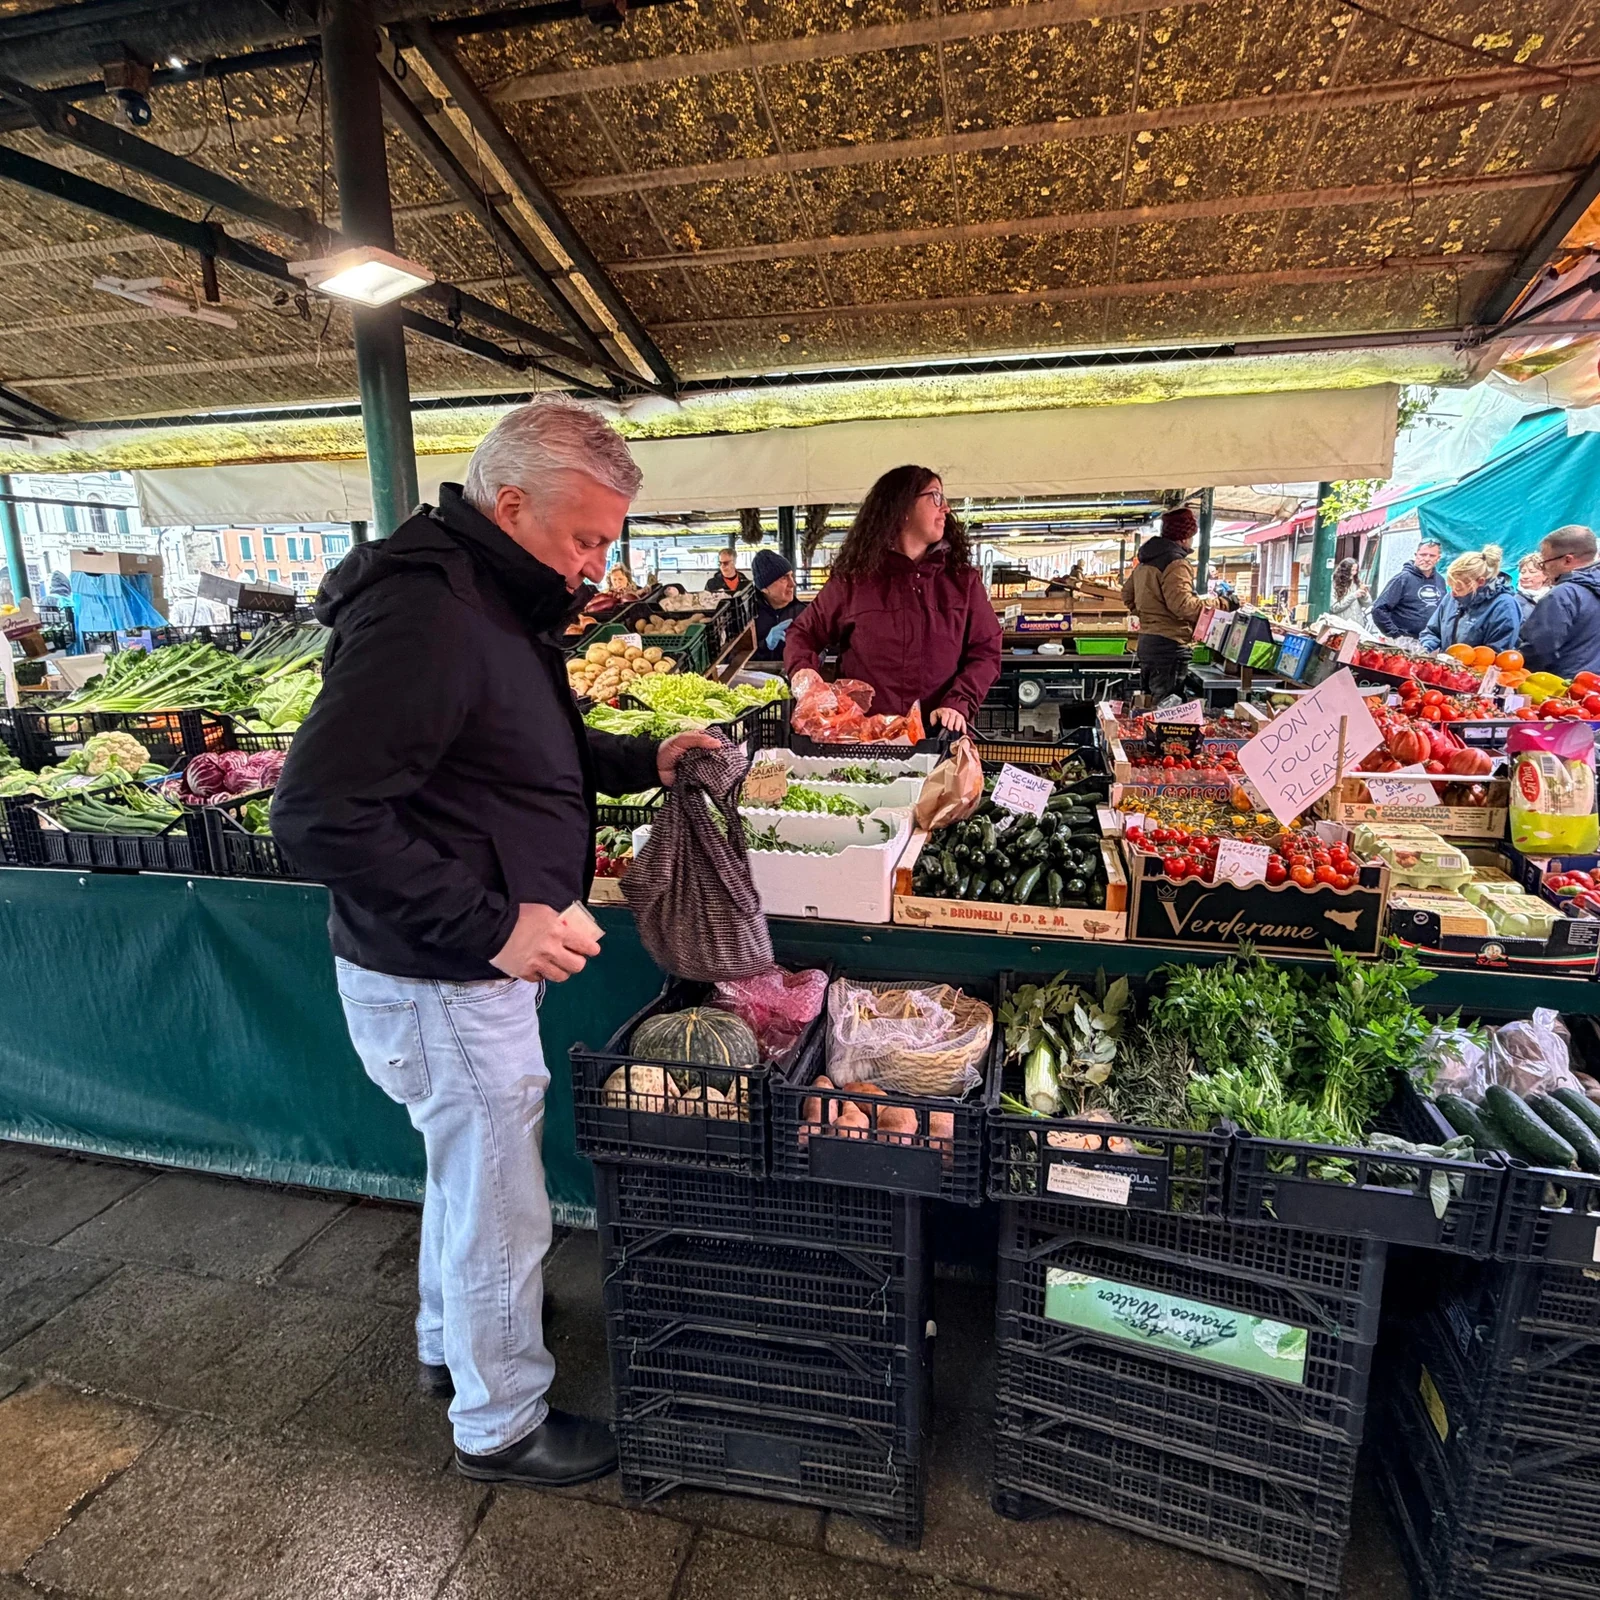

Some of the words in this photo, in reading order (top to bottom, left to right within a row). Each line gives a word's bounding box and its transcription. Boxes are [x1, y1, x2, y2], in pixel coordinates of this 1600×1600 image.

[1153, 702, 1198, 720] DATTERINO
[1260, 690, 1324, 755] DON'T
[1262, 723, 1339, 783] TOUCH
[1003, 766, 1049, 791] ZUCCHINE
[1280, 742, 1357, 804] PLEASE
[1385, 781, 1405, 792] BUE
[1381, 811, 1451, 820] SACCAGNANA
[1382, 805, 1451, 814] COOPERATIVA
[950, 907, 1003, 922] BRUNELLI
[1010, 912, 1035, 925] G.D.
[1038, 914, 1047, 925] &
[1053, 915, 1069, 927] M.
[1158, 892, 1320, 941] Verderame
[1096, 1289, 1161, 1320] Walter
[1123, 1317, 1166, 1338] Agr.
[1168, 1307, 1238, 1339] Franco
[1177, 1329, 1214, 1350] Az.
